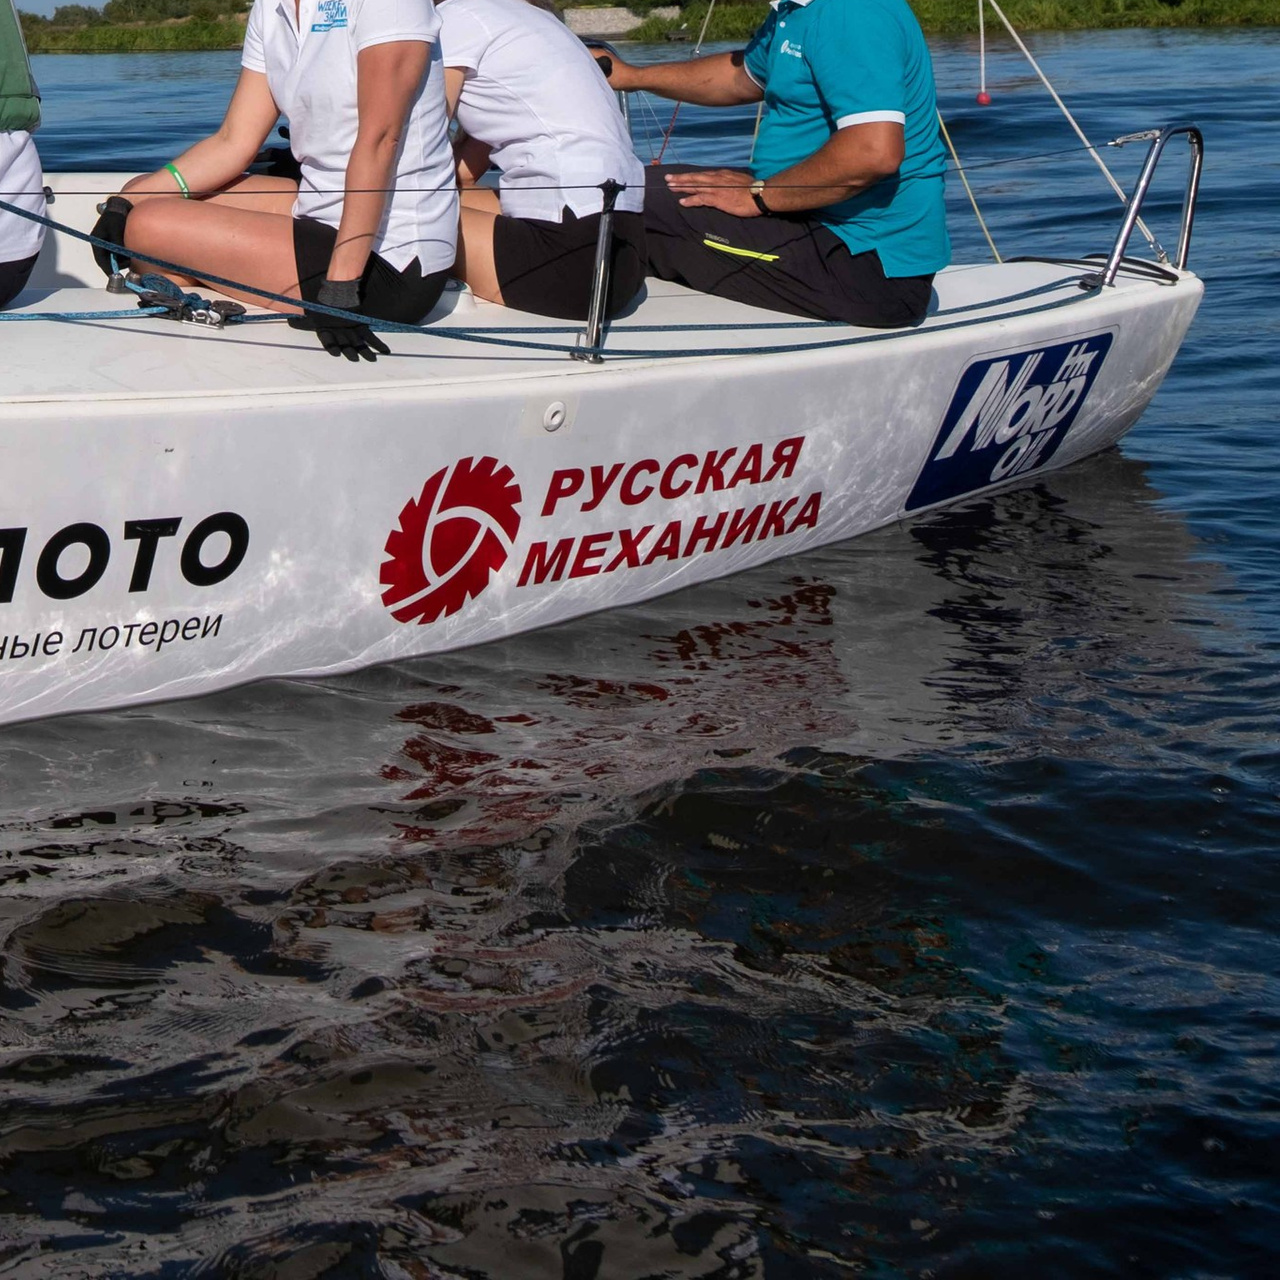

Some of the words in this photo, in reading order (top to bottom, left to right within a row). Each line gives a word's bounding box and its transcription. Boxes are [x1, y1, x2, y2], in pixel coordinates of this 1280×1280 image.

[541, 436, 806, 517] РУССКАЯ
[516, 491, 822, 587] МЕХАНИКА
[72, 613, 223, 652] лотереи
